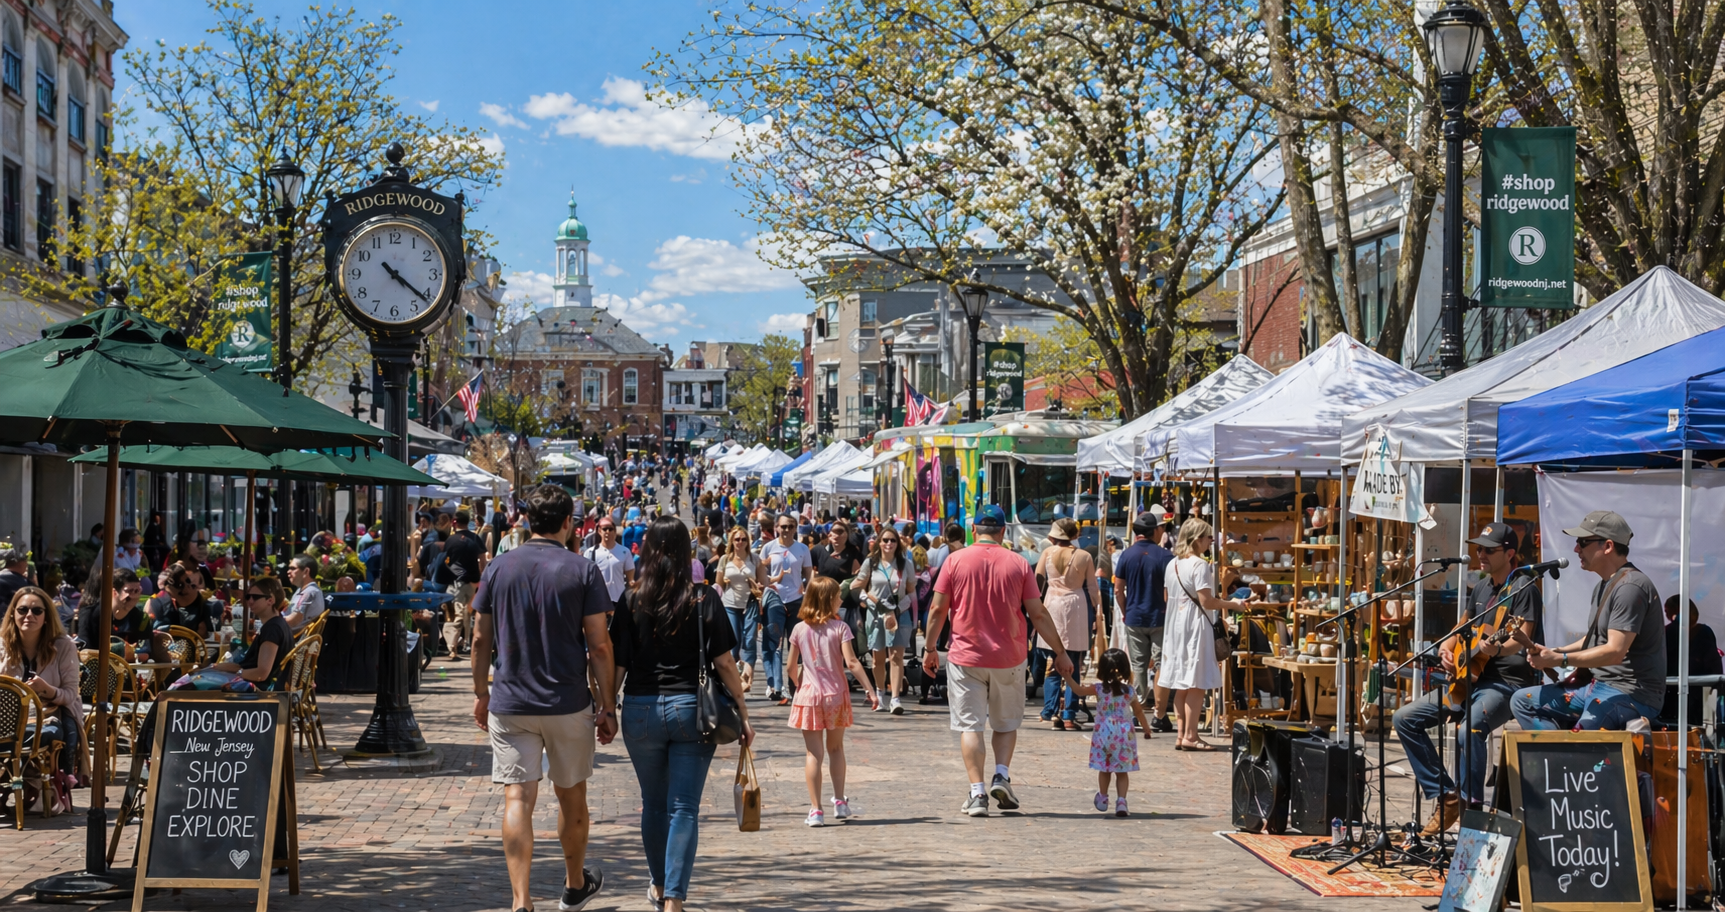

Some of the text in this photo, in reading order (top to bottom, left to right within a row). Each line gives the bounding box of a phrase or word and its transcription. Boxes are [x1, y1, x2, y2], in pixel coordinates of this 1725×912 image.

[1501, 173, 1556, 195] #shop
[344, 192, 446, 216] RIDGEWOOD
[1486, 193, 1570, 214] ridgewood
[372, 236, 381, 249] 11
[389, 231, 402, 245] 12
[411, 236, 416, 249] 1
[1517, 233, 1539, 258] R
[358, 250, 371, 262] 10
[422, 249, 432, 262] 2
[351, 267, 362, 280] 9
[428, 267, 438, 281] 3
[1488, 277, 1567, 290] ridgewoodnj.net
[357, 286, 367, 299] 8
[422, 287, 431, 299] 4
[372, 299, 381, 312] 7
[390, 305, 399, 317] 6
[409, 300, 419, 312] 5
[237, 325, 250, 343] R
[171, 709, 272, 733] RIDGEWOOD
[184, 736, 255, 759] New Jersey
[186, 760, 248, 783] SHOP
[1544, 758, 1599, 793] Live
[186, 787, 240, 809] DINE
[1550, 796, 1614, 831] Music
[167, 814, 256, 838] EXPLORE
[1538, 829, 1620, 888] Today!
